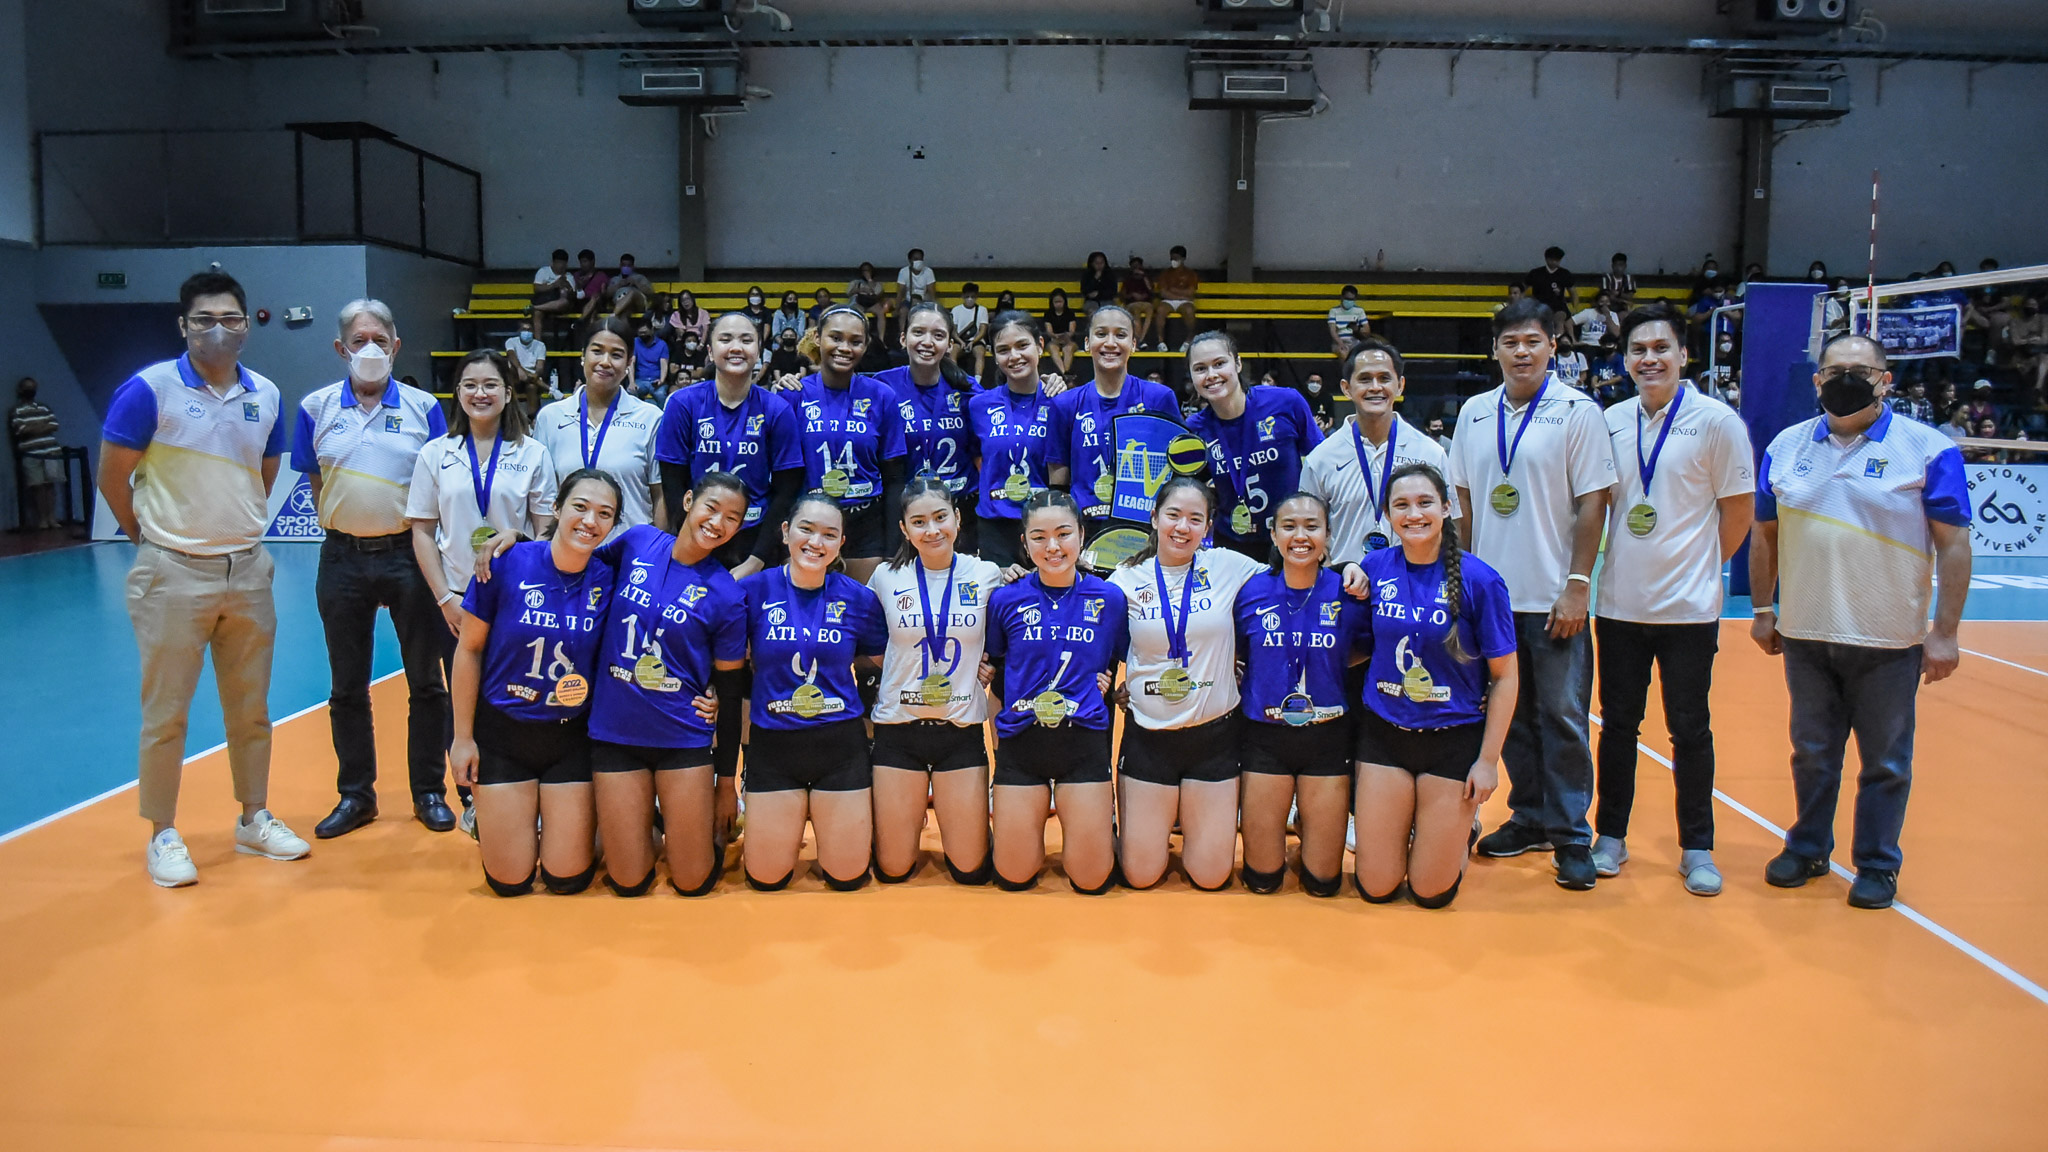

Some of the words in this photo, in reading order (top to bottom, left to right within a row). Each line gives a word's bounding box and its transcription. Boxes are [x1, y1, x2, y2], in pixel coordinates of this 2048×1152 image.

[611, 420, 647, 430] ATENEO
[806, 420, 867, 433] ATEO
[904, 417, 963, 433] AENEO
[1530, 416, 1564, 426] TENEO
[698, 440, 759, 455] ATEO
[496, 462, 529, 472] TENEO
[816, 441, 858, 479] 14
[1967, 468, 2038, 494] BEYOND
[1246, 473, 1269, 513] 5
[276, 515, 319, 526] SPOR
[1968, 513, 2046, 553] CTIVEWEAR
[526, 590, 544, 608] MG
[620, 583, 687, 624] ATEEO
[768, 608, 787, 625] MG
[1023, 609, 1041, 625] MG
[1138, 597, 1212, 621] ATNEO
[1376, 601, 1447, 625] ATENO
[519, 609, 595, 632] ATEO
[1262, 612, 1280, 630] MG
[1262, 632, 1336, 648] ATEO
[914, 636, 962, 680] 19
[562, 679, 582, 688] 2022
[1317, 710, 1341, 719] Smart
